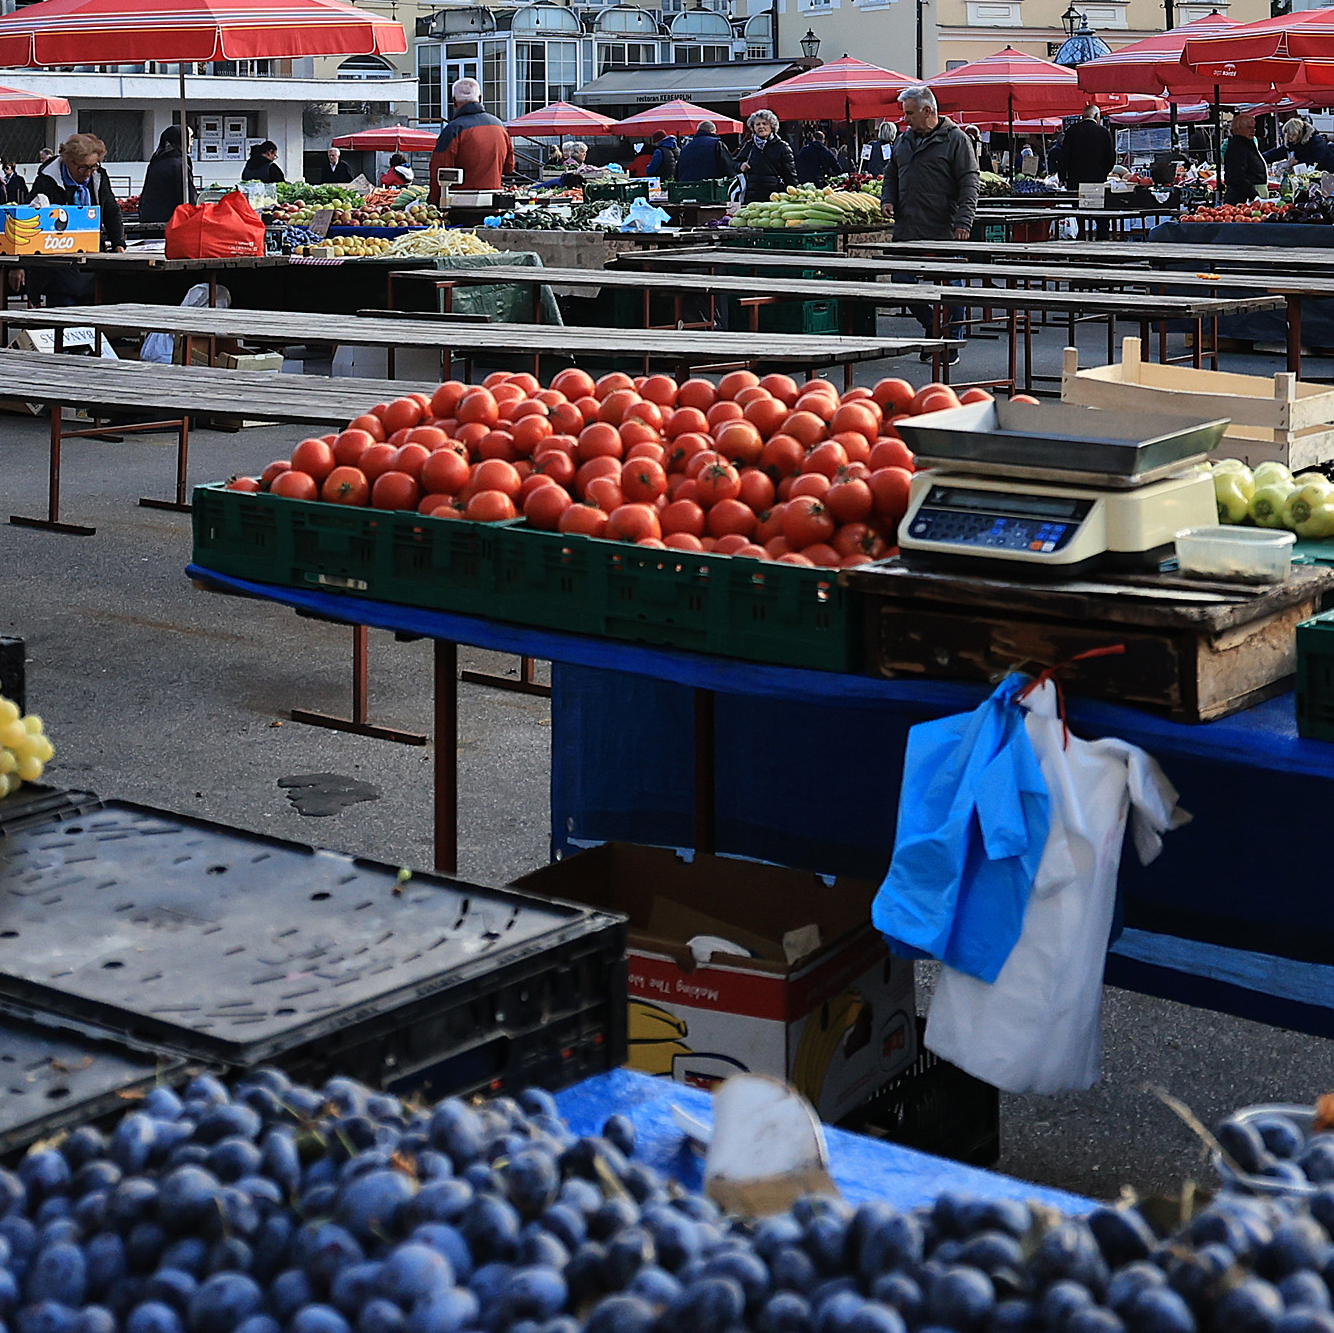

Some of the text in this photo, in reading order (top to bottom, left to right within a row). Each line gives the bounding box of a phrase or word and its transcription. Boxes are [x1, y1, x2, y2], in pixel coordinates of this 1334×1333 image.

[43, 234, 76, 249] toco
[40, 329, 95, 344] BANAAS
[650, 978, 671, 994] The
[676, 980, 720, 1002] Making
